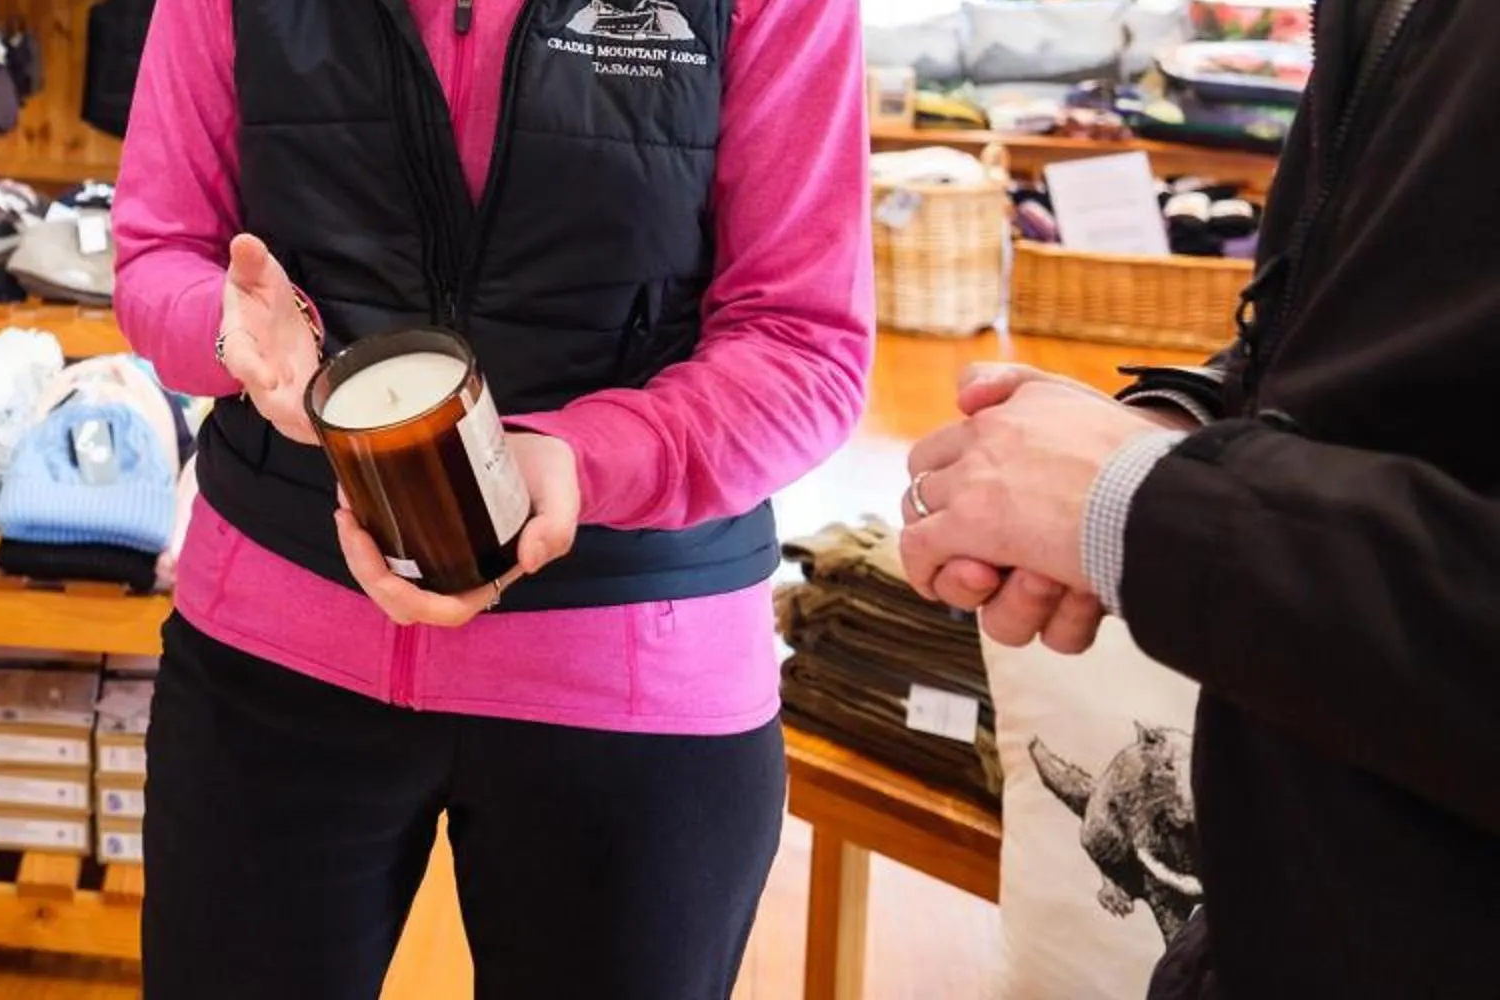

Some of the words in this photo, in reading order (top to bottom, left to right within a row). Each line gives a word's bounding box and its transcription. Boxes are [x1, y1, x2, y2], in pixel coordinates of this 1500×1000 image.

[547, 37, 595, 55] CRADLE
[597, 45, 668, 61] MOUNTAIN
[670, 50, 707, 66] LODGE
[591, 61, 663, 78] TASMANIA
